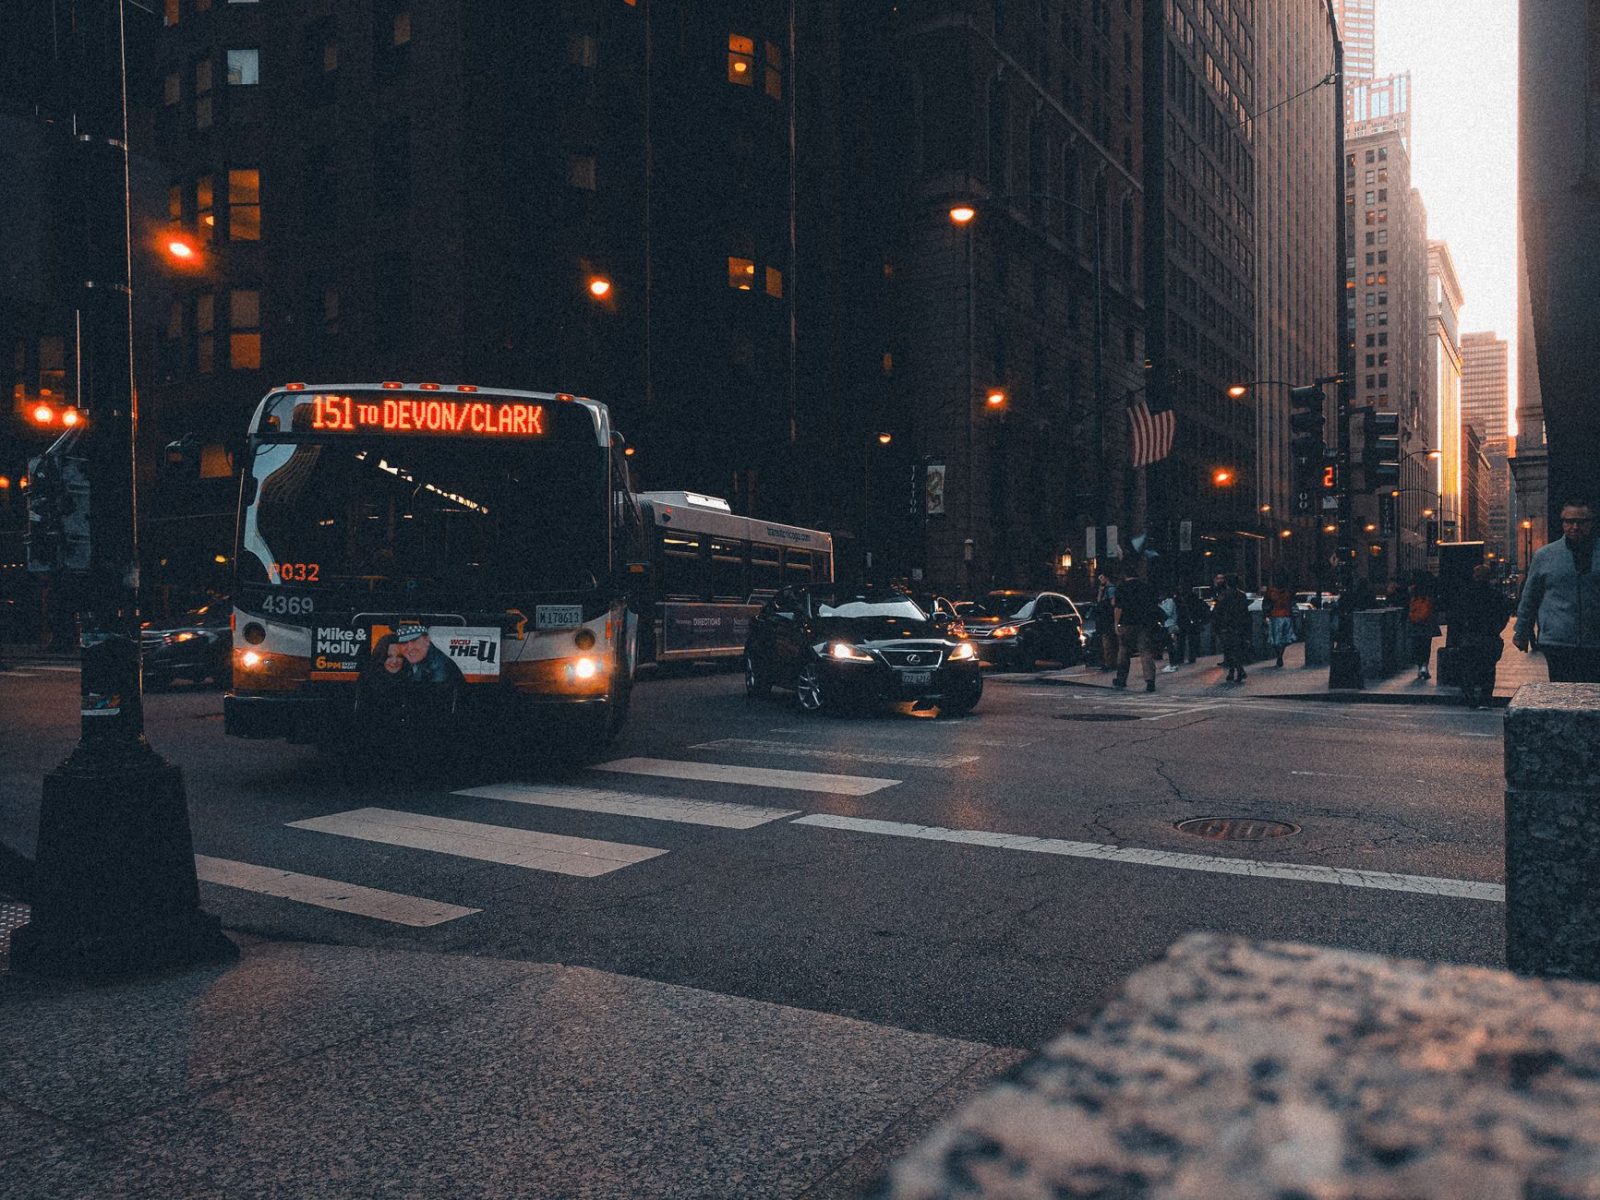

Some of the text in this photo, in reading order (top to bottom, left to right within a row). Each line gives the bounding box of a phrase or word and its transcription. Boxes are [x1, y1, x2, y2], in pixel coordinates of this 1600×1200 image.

[312, 396, 543, 434] 151 TO DEVON/CLARK
[1323, 465, 1336, 488] 2
[262, 595, 314, 614] 4369
[317, 627, 367, 641] Mike &
[316, 641, 361, 656] Molly
[449, 645, 478, 657] THE
[315, 655, 342, 670] 6PM
